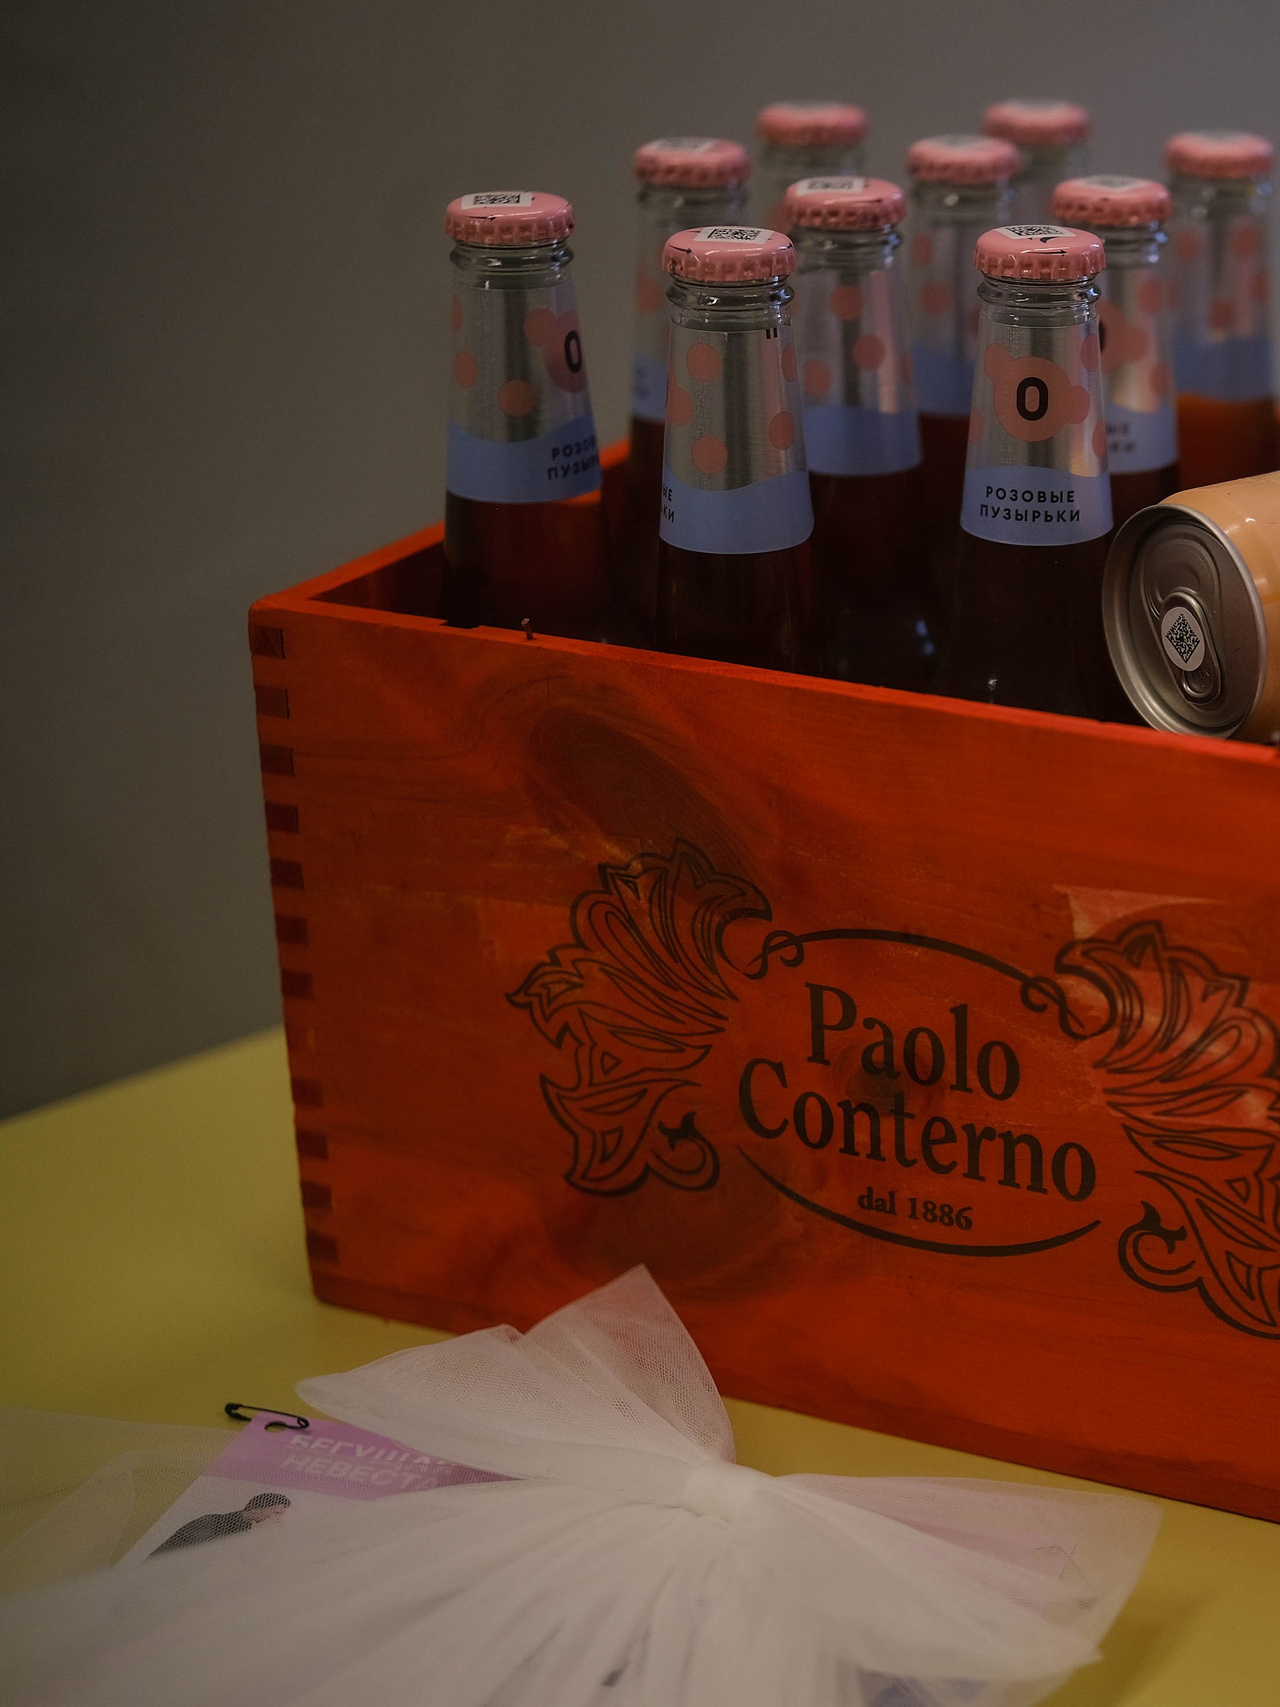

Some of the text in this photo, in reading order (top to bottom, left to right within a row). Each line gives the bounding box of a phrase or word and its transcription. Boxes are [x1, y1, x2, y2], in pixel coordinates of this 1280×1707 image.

[980, 503, 1080, 523] ПУЗЫРЬКИ
[986, 485, 1075, 503] РОЗОВЫЕ
[803, 981, 1022, 1101] Paolo
[738, 1057, 1097, 1201] Conterno
[857, 1186, 973, 1231] dal 1886
